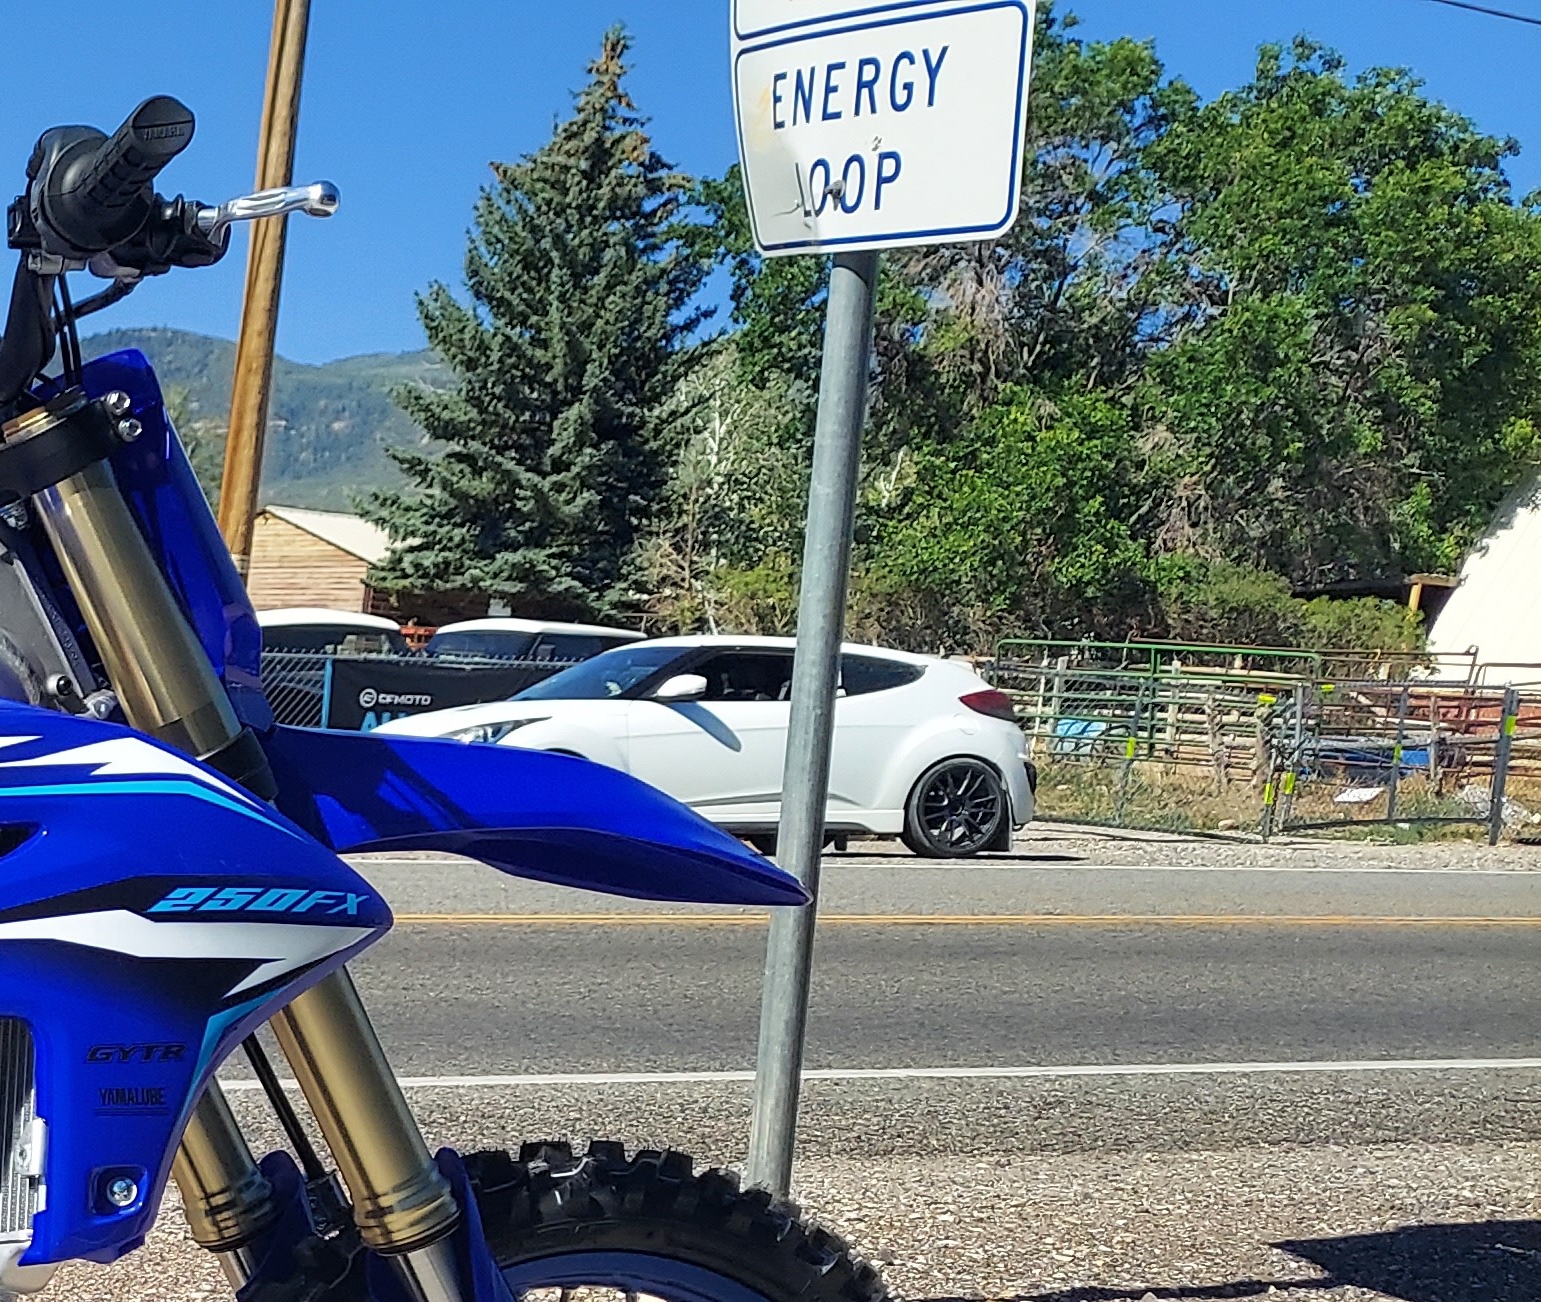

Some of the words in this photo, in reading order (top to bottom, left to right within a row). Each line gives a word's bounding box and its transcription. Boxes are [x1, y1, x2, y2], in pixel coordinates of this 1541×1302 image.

[772, 45, 950, 130] ENERGY
[146, 886, 370, 916] 250FX
[85, 1041, 188, 1064] GYTR
[98, 1087, 168, 1106] YAMALUBE
